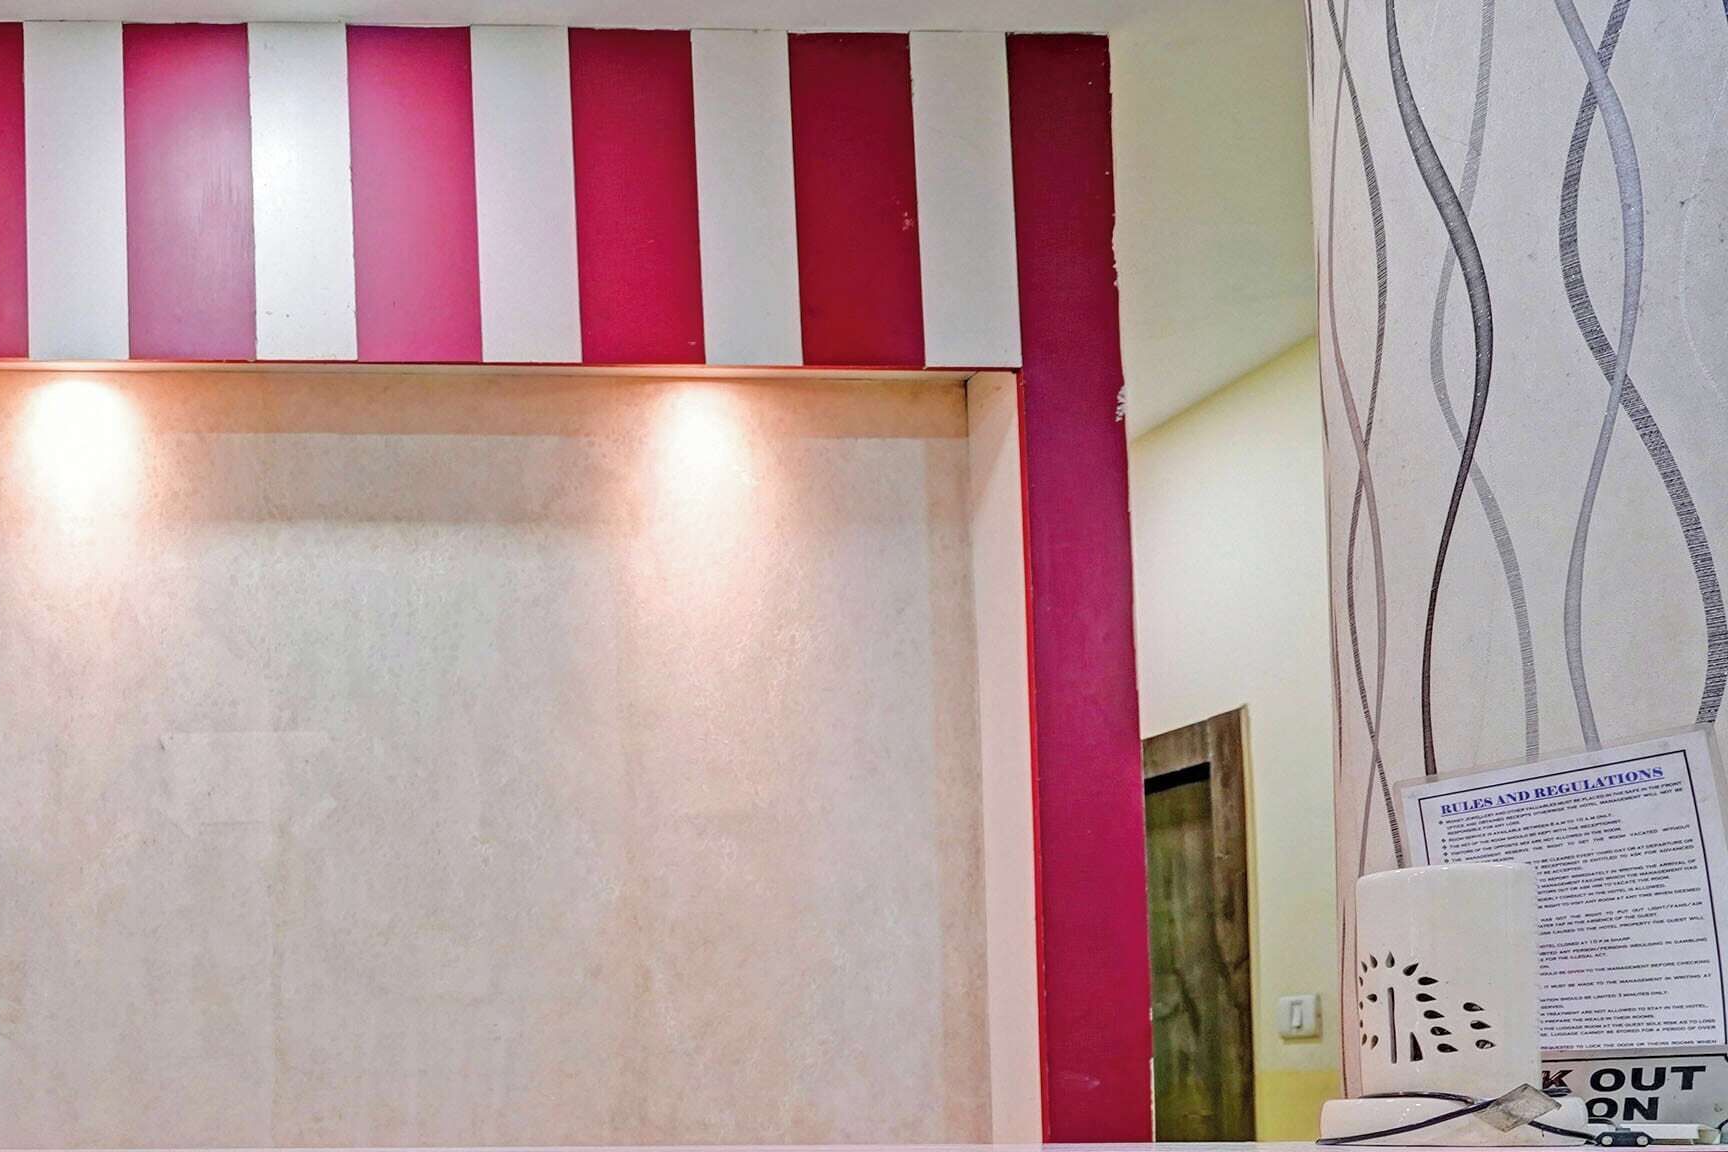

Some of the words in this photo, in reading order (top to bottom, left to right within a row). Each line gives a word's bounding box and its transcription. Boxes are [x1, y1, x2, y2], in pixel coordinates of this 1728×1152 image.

[1441, 797, 1493, 814] RULES
[1494, 791, 1531, 805] AND
[1534, 767, 1664, 798] REGULATIONS
[1590, 1065, 1707, 1093] OUT
[1585, 1096, 1660, 1121] ON
